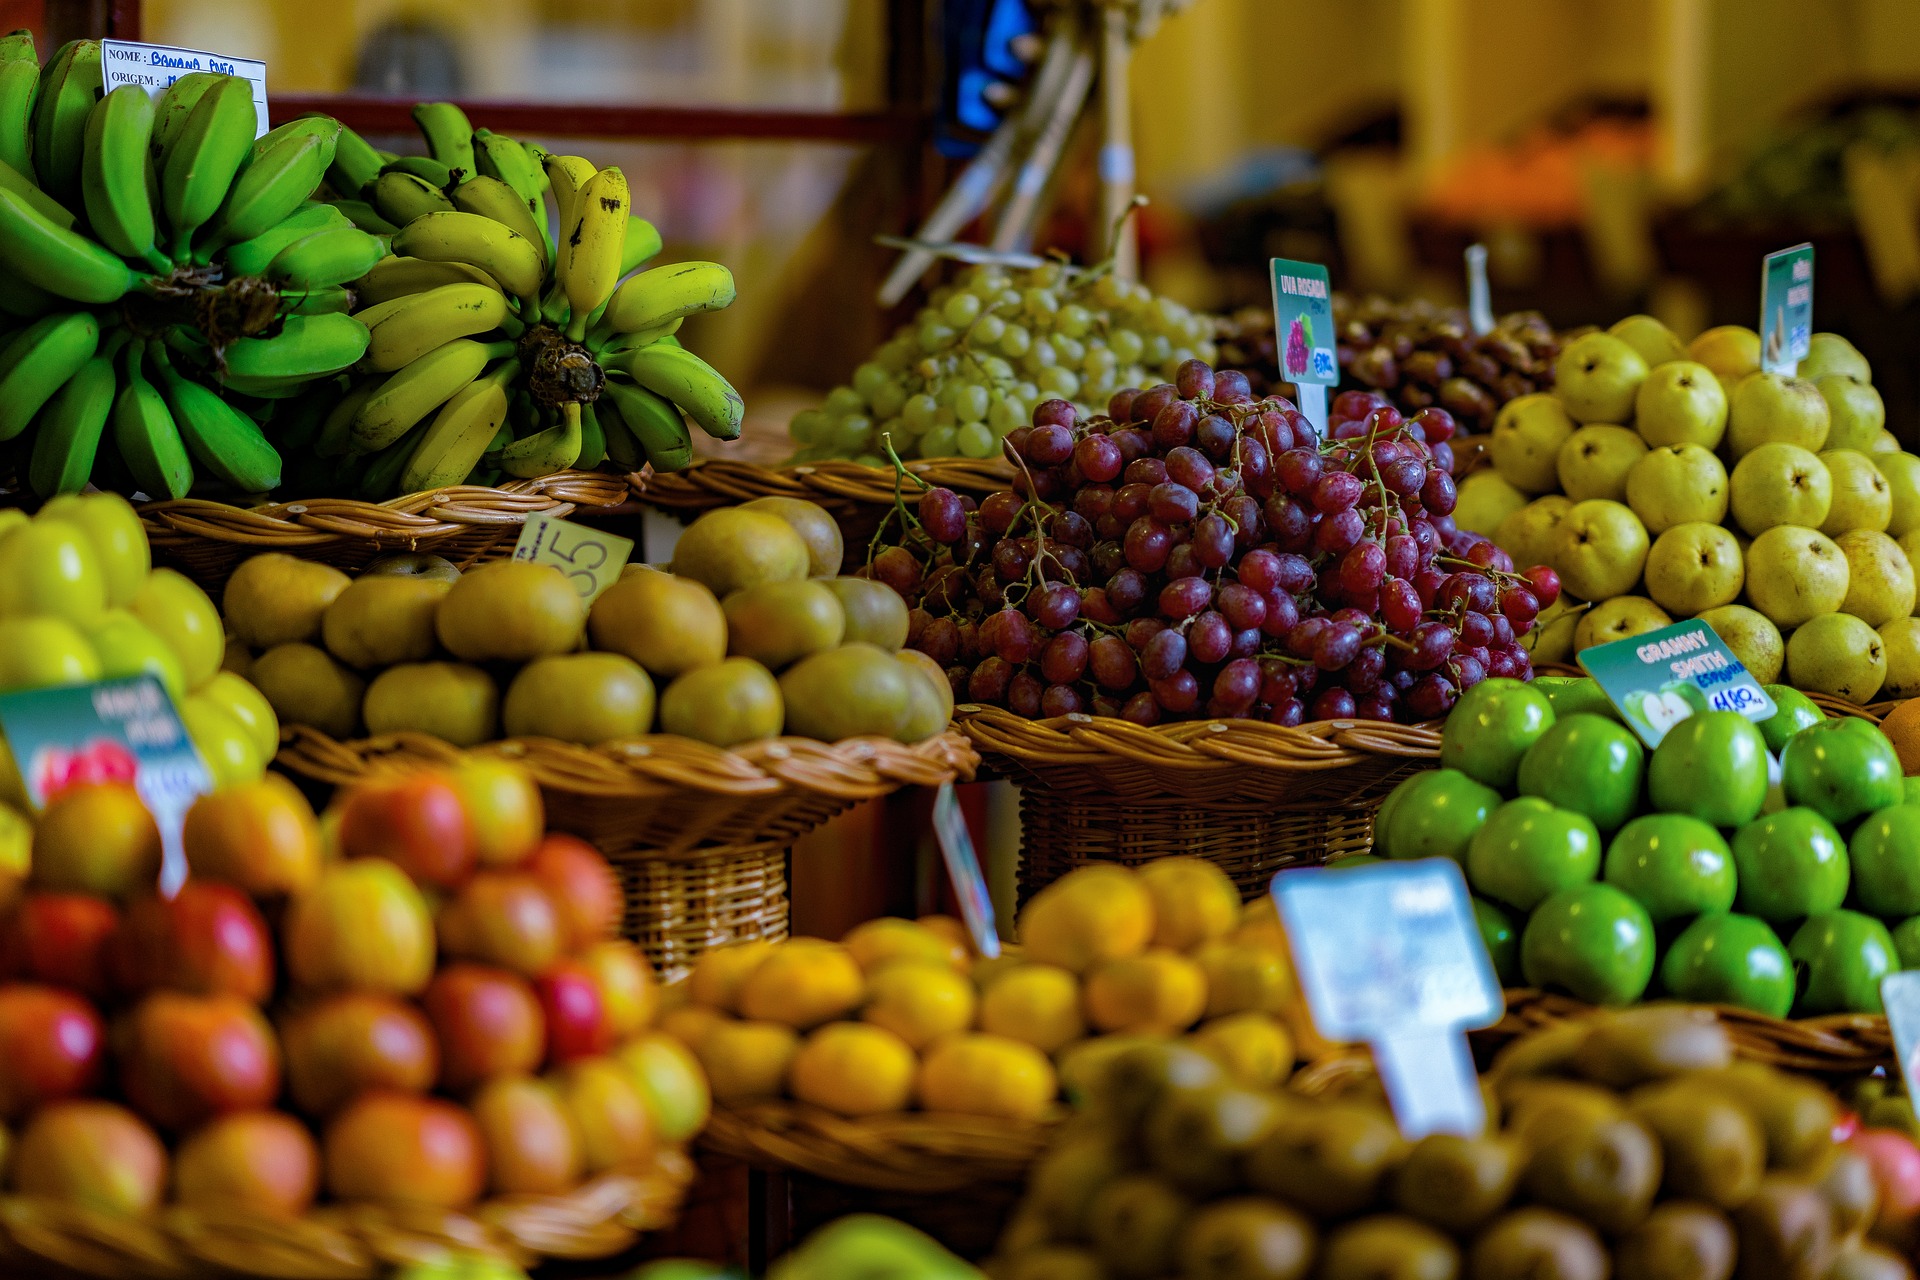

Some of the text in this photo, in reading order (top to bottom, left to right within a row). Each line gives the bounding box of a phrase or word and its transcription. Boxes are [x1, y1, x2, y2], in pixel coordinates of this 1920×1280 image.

[151, 51, 200, 70] BANANA
[1280, 274, 1298, 296] UVA
[1636, 628, 1709, 665] GRANNY
[1669, 650, 1728, 679] SMITH
